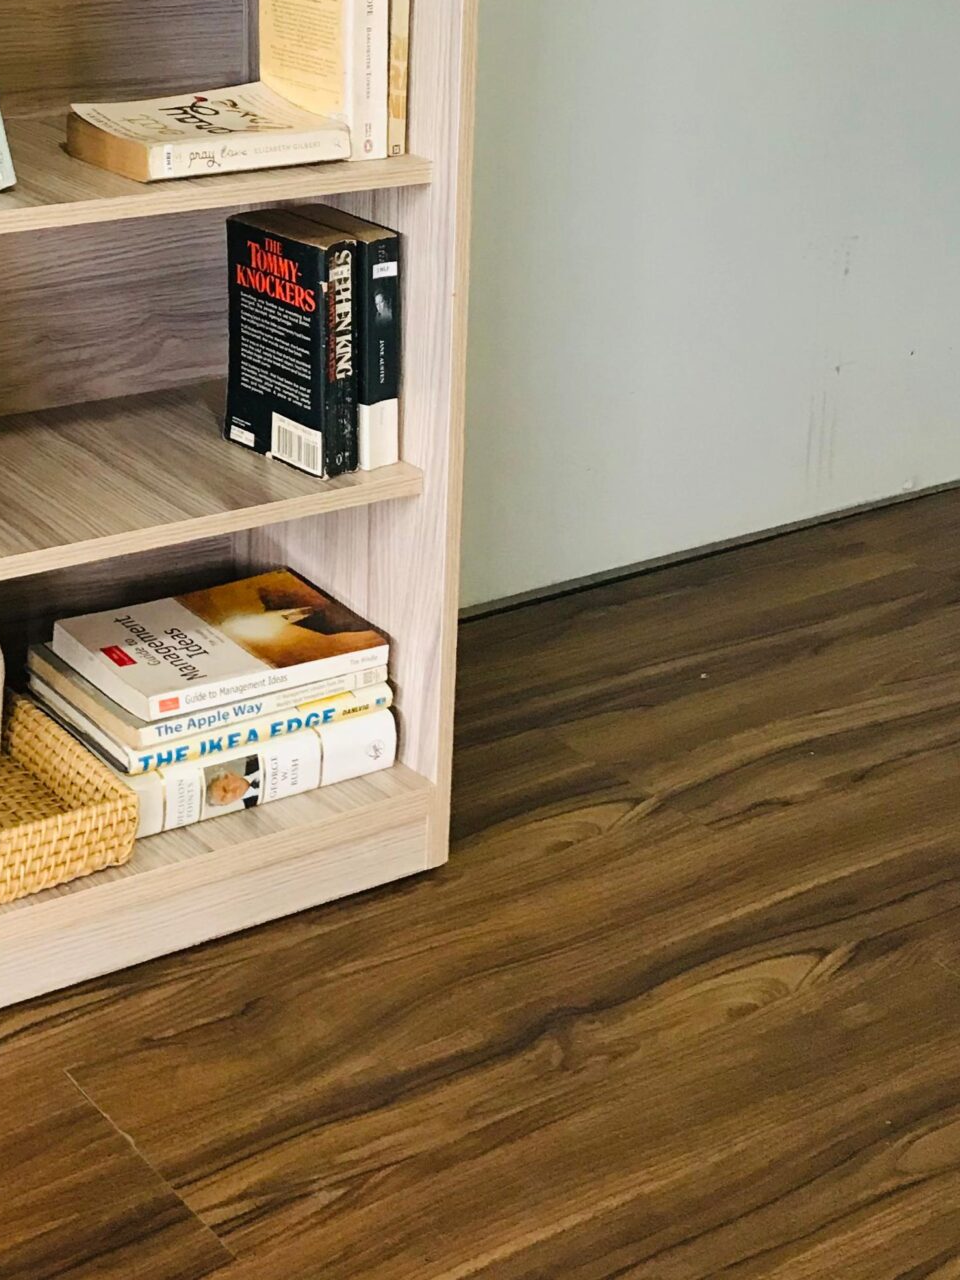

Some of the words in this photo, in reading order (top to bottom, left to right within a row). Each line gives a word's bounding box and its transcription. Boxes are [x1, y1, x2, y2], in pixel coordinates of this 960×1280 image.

[188, 150, 221, 168] pray
[247, 240, 302, 283] TOMMY-
[265, 237, 283, 255] THE
[236, 263, 316, 312] KNOCKERS
[335, 336, 353, 380] KING
[113, 615, 207, 681] Management
[124, 638, 138, 646] to
[135, 647, 161, 666] Guide
[164, 627, 210, 659] Ideas
[185, 691, 207, 704] Guide
[208, 690, 217, 699] to
[219, 679, 266, 696] Management
[268, 674, 288, 686] Ideas
[155, 723, 183, 738] The
[186, 710, 230, 731] Apple
[233, 701, 263, 717] Way
[139, 745, 189, 772] THE
[199, 728, 259, 756] IKEA
[270, 708, 336, 737] EDGE
[270, 756, 278, 798] GEORGE
[291, 758, 299, 786] BUSH
